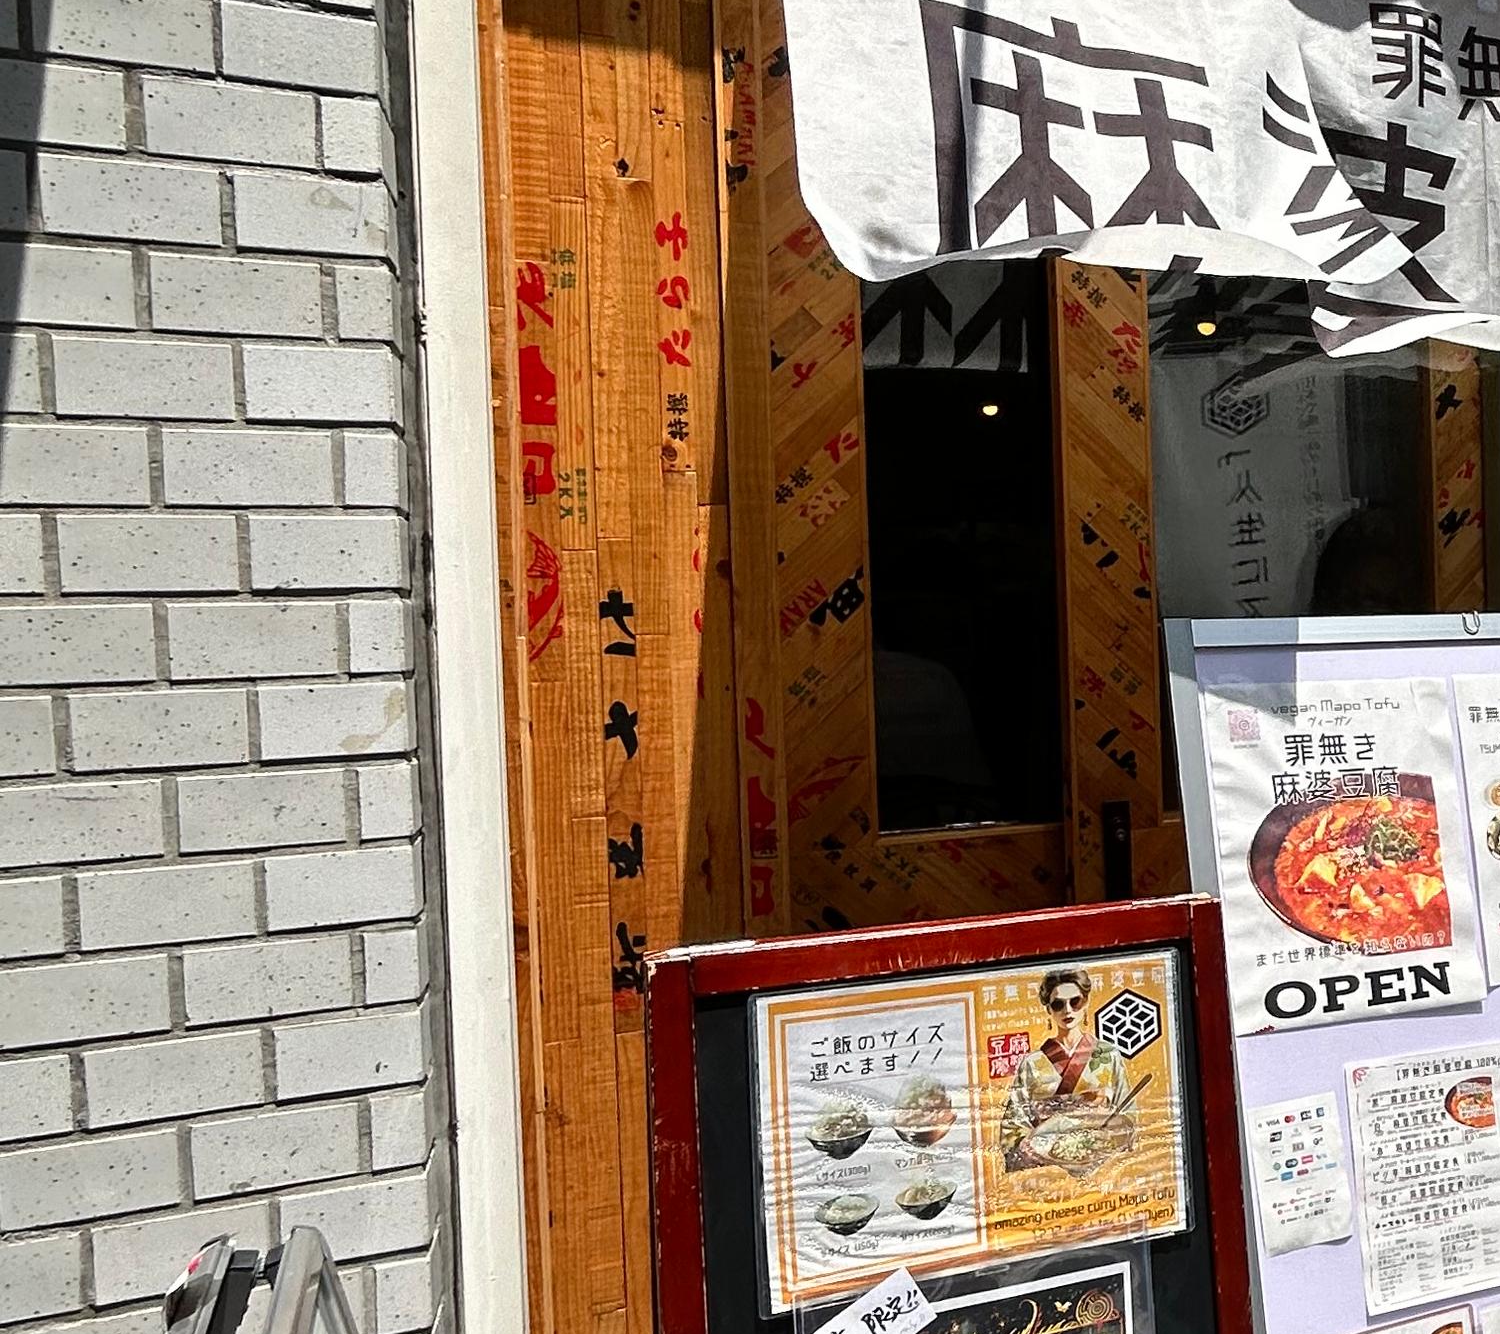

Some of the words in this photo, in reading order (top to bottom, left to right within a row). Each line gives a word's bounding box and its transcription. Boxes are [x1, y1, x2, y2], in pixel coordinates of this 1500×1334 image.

[1271, 703, 1317, 717] vegan
[1320, 699, 1361, 714] Mapo
[1366, 697, 1400, 710] Tofu
[1284, 733, 1376, 766] 罪無き
[1272, 766, 1401, 805] 麻婆豆腐
[1264, 961, 1451, 1019] OPEN
[810, 1023, 946, 1059] ご飯のサイズ
[1266, 1118, 1281, 1127] VISA
[994, 1213, 1042, 1231] amazing
[1045, 1205, 1084, 1222] cheese
[1087, 1198, 1117, 1213] curry
